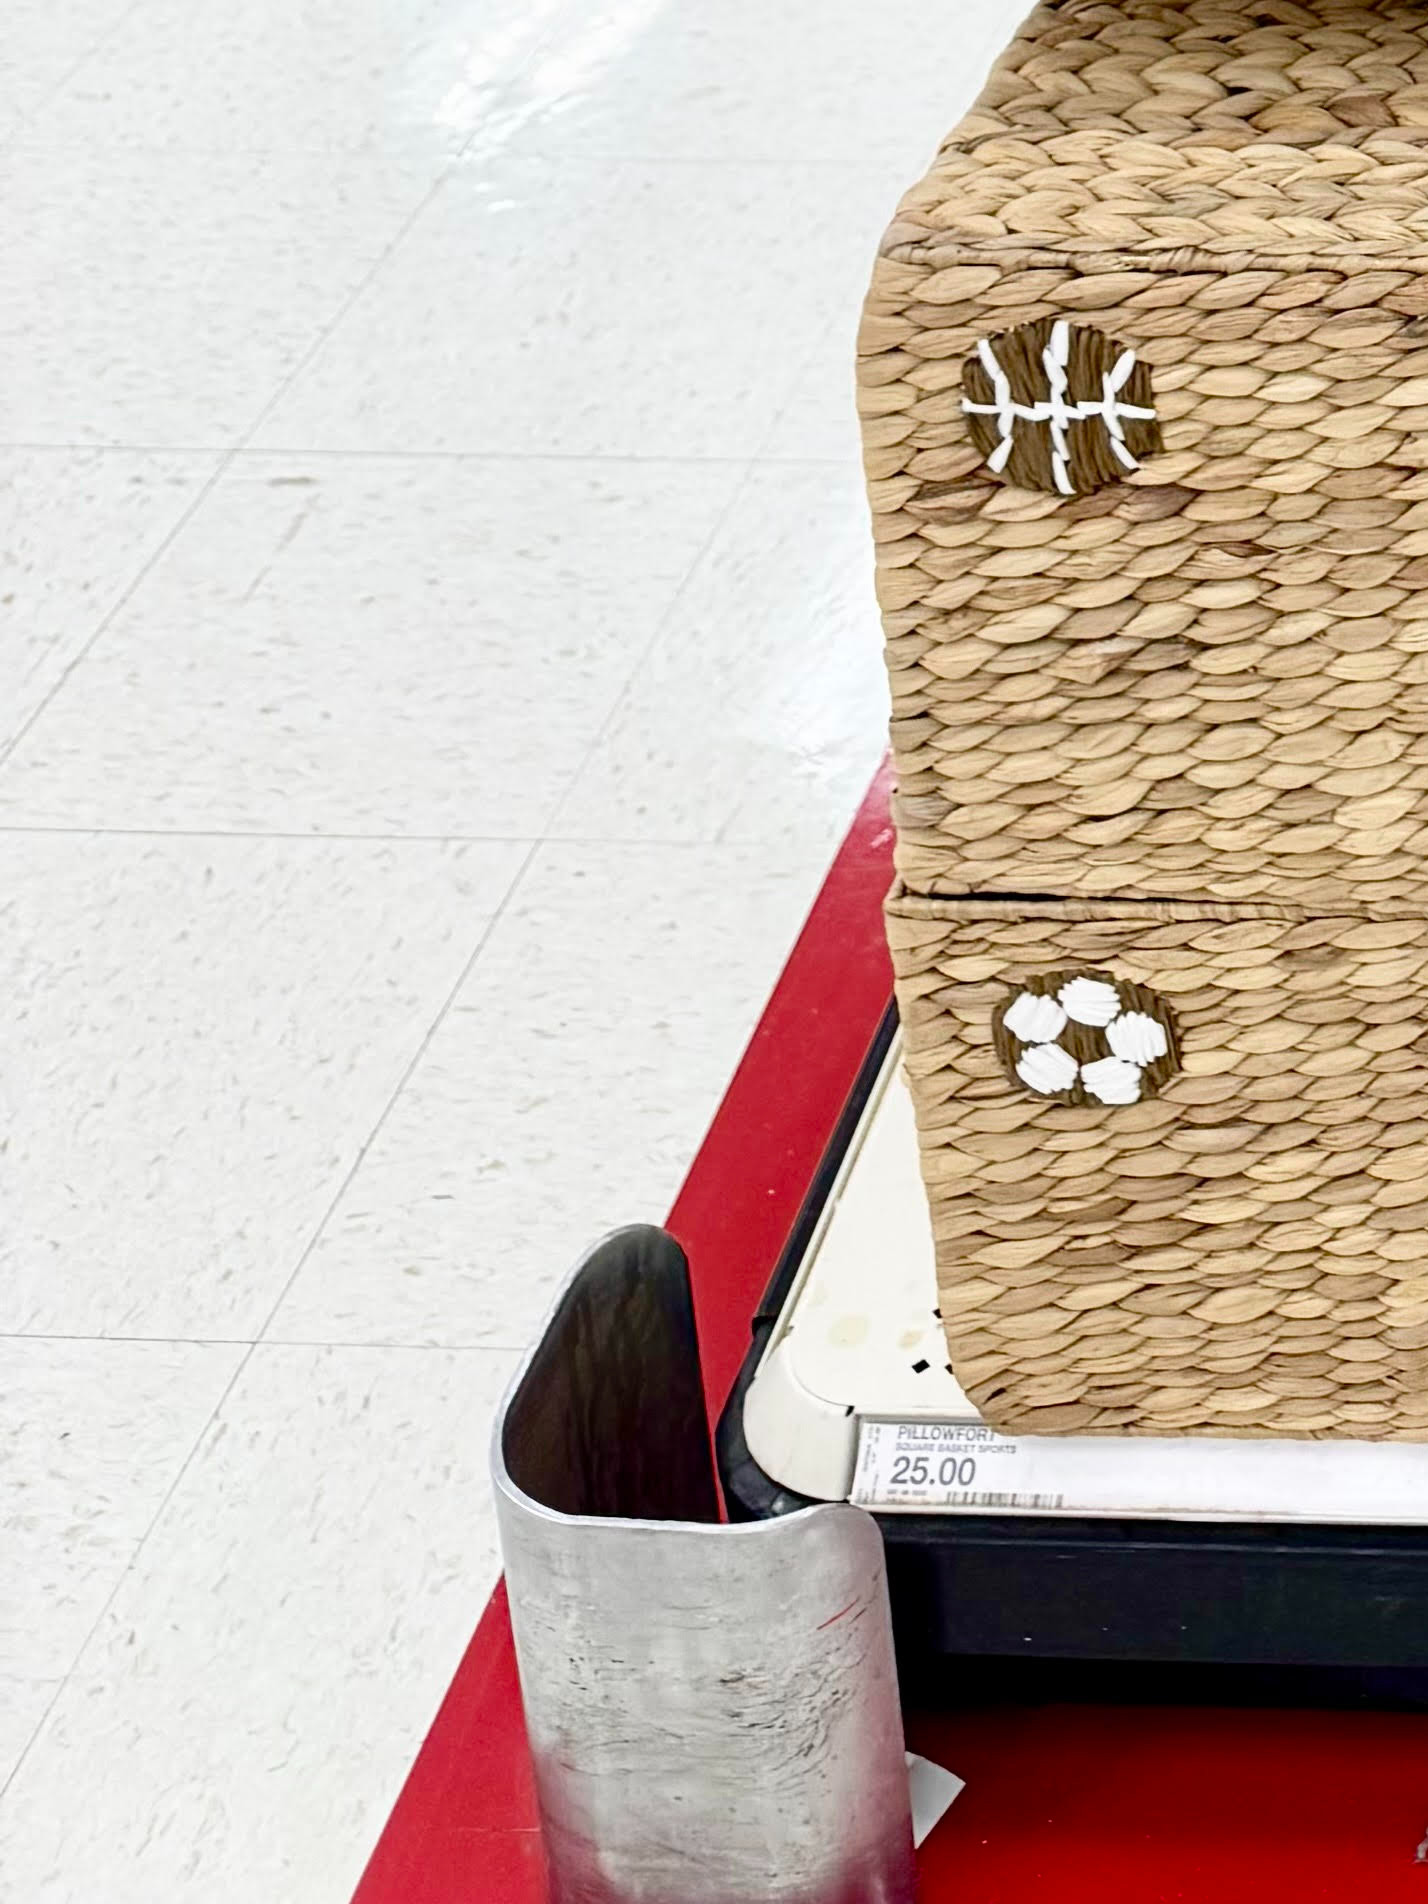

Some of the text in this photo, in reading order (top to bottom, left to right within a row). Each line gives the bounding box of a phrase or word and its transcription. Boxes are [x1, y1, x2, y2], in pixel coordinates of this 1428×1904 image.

[897, 1426, 995, 1441] PILLOWFORT
[896, 1443, 1017, 1454] SQUARE BASKET SPORTS
[890, 1456, 976, 1486] 25.00
